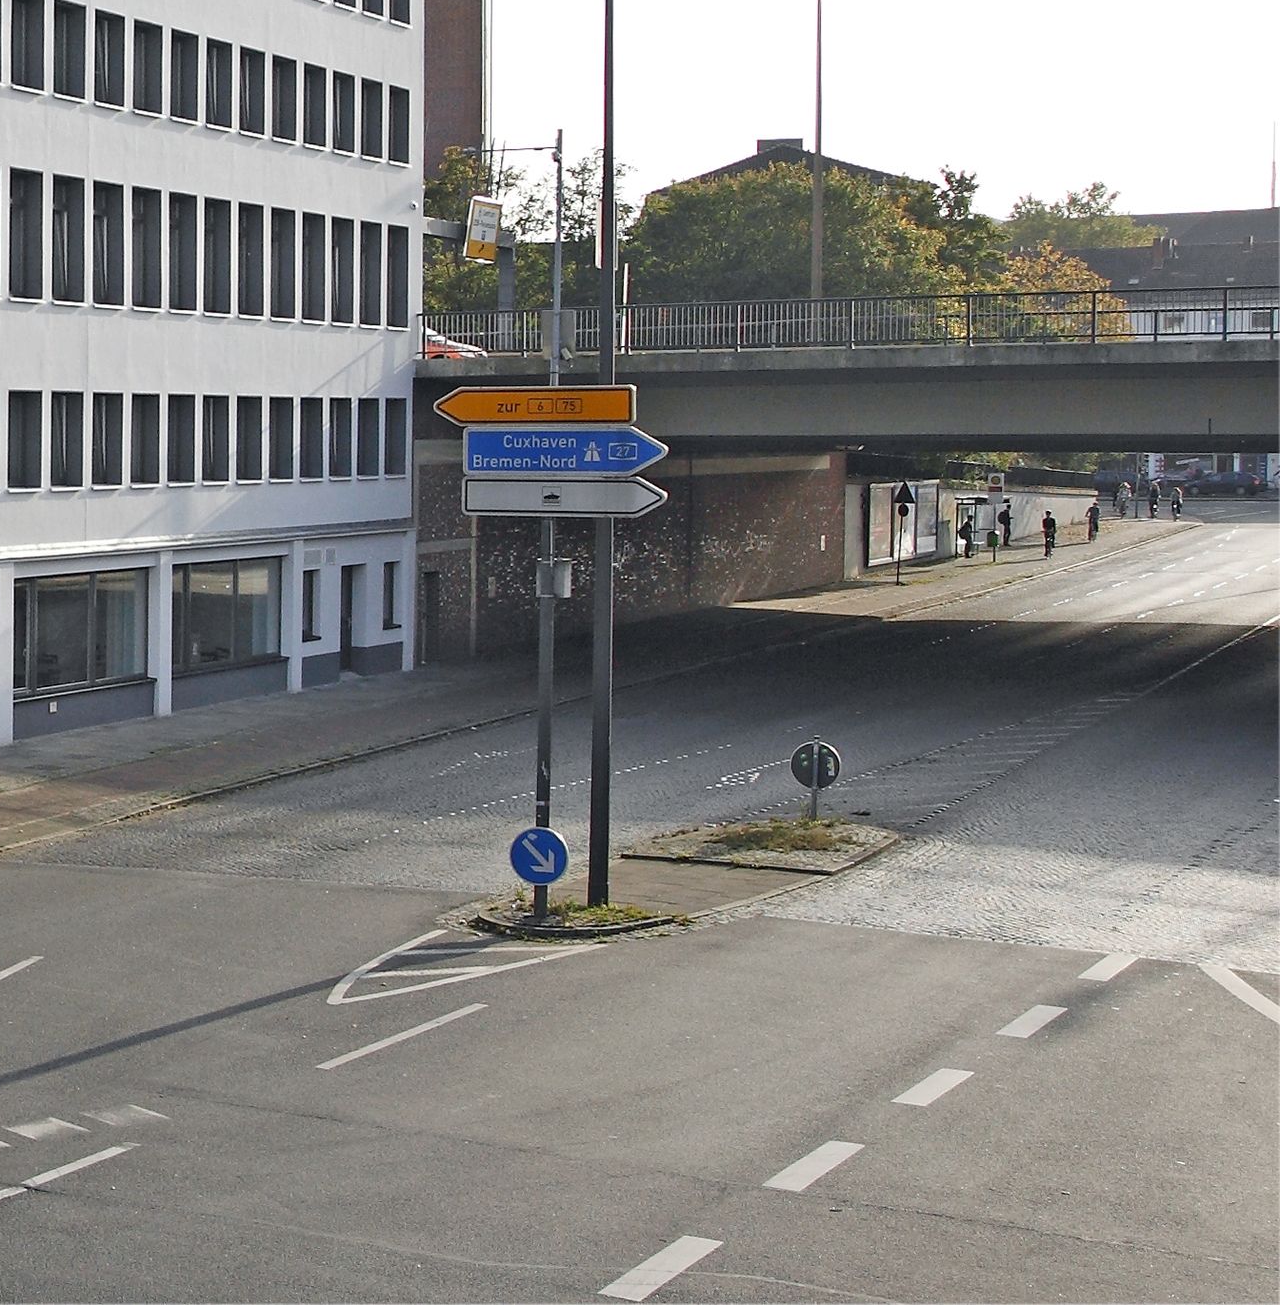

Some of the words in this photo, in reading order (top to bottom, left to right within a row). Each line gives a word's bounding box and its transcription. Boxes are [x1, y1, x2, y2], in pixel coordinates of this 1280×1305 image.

[497, 402, 520, 413] zur
[537, 401, 544, 411] 6
[563, 401, 576, 411] 75
[503, 435, 576, 448] Cuxhaven
[616, 446, 630, 457] 27
[473, 454, 576, 468] Bremen-Nord
